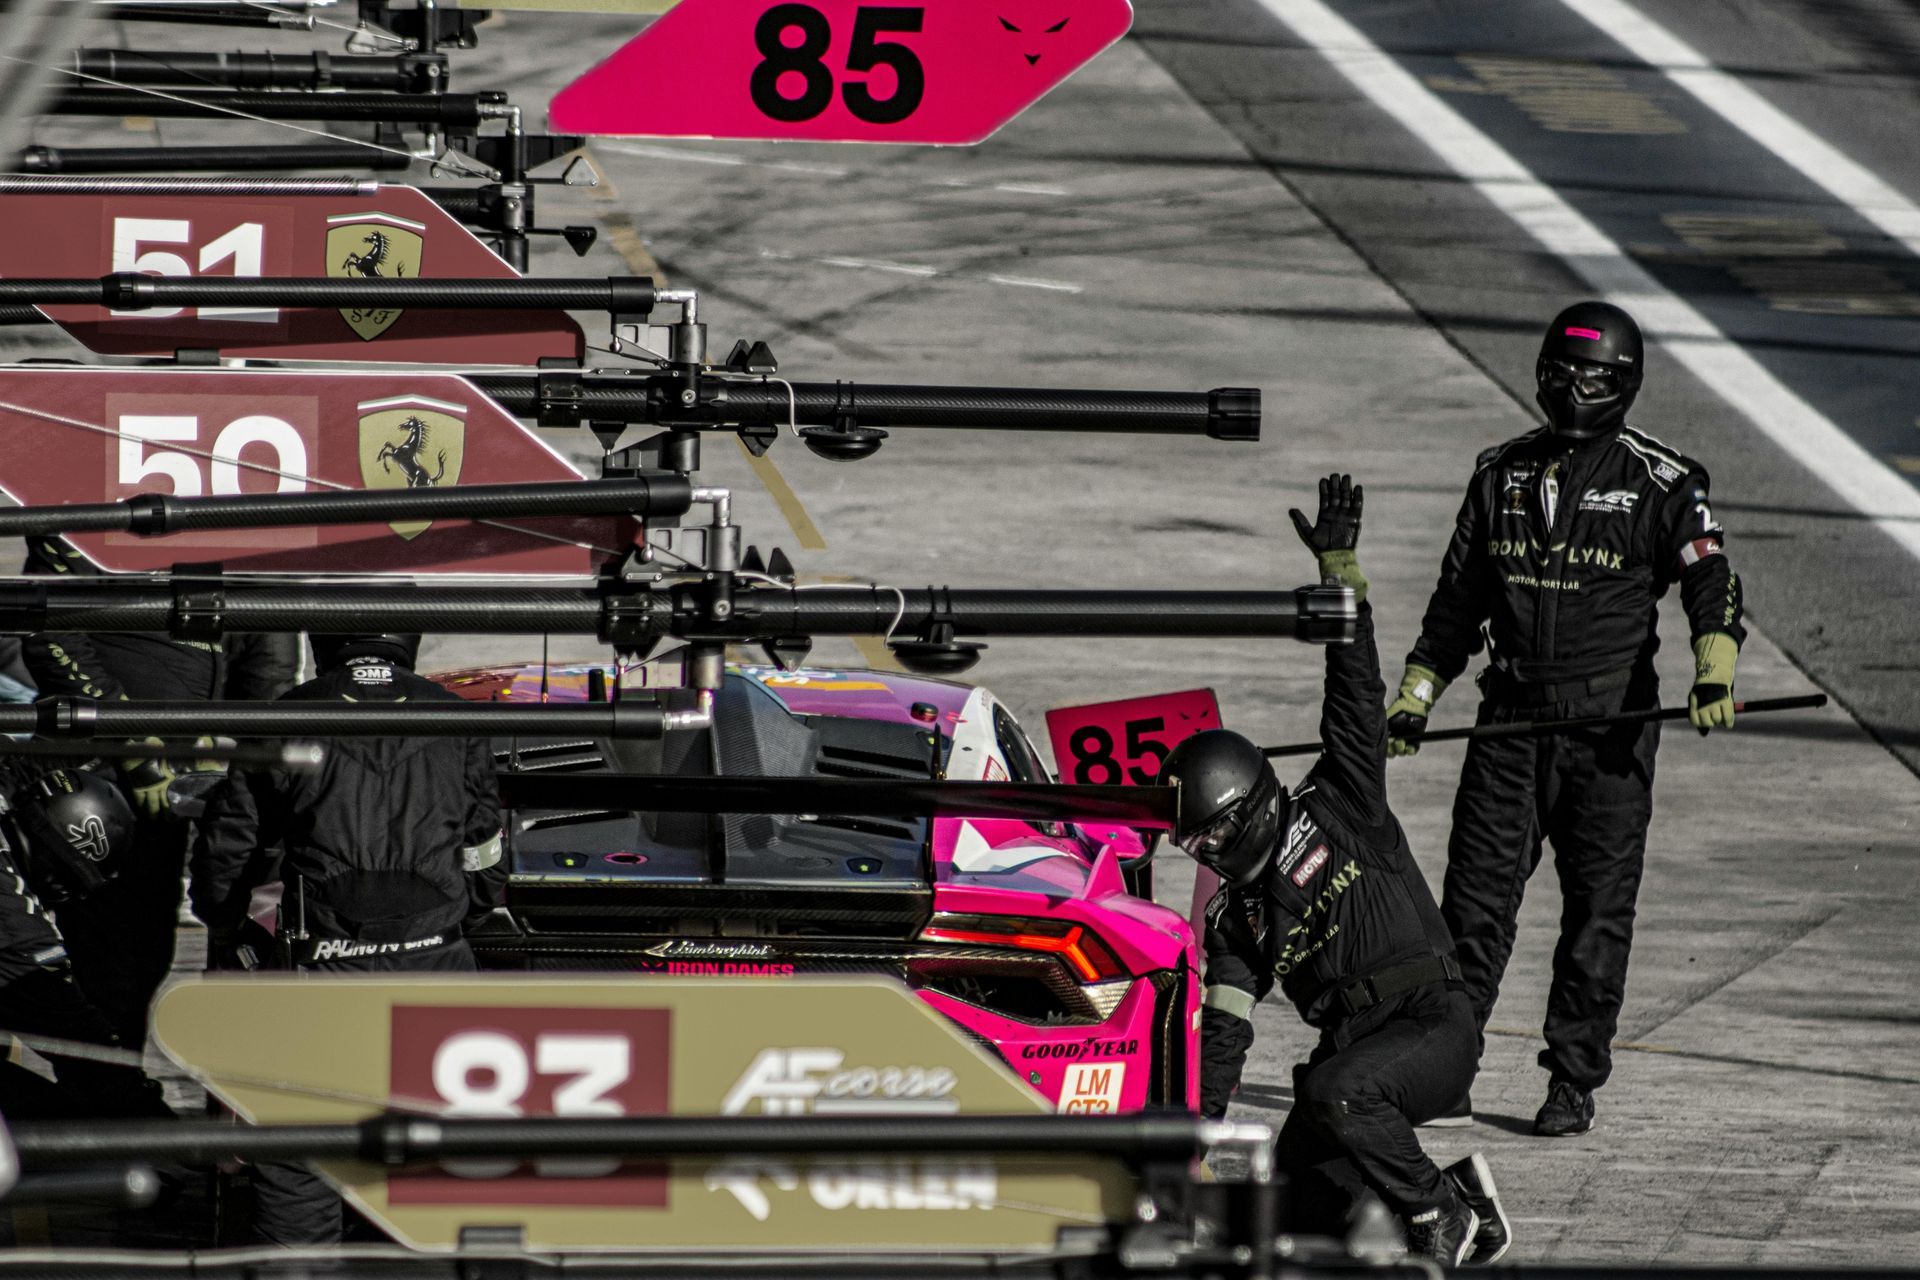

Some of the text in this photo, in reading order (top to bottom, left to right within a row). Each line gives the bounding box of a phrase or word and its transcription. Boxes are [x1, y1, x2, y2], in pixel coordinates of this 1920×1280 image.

[750, 3, 924, 124] 85
[110, 218, 279, 323] 51
[117, 415, 307, 503] 50
[1568, 546, 1624, 570] LYNX
[1563, 581, 1580, 590] LAB
[353, 669, 393, 680] OMP
[1069, 716, 1171, 786] 85
[1296, 847, 1329, 885] MOTUL
[667, 961, 795, 978] IRON DAMES
[1022, 1037, 1139, 1060] GOODYEAR
[1075, 1069, 1112, 1096] LM
